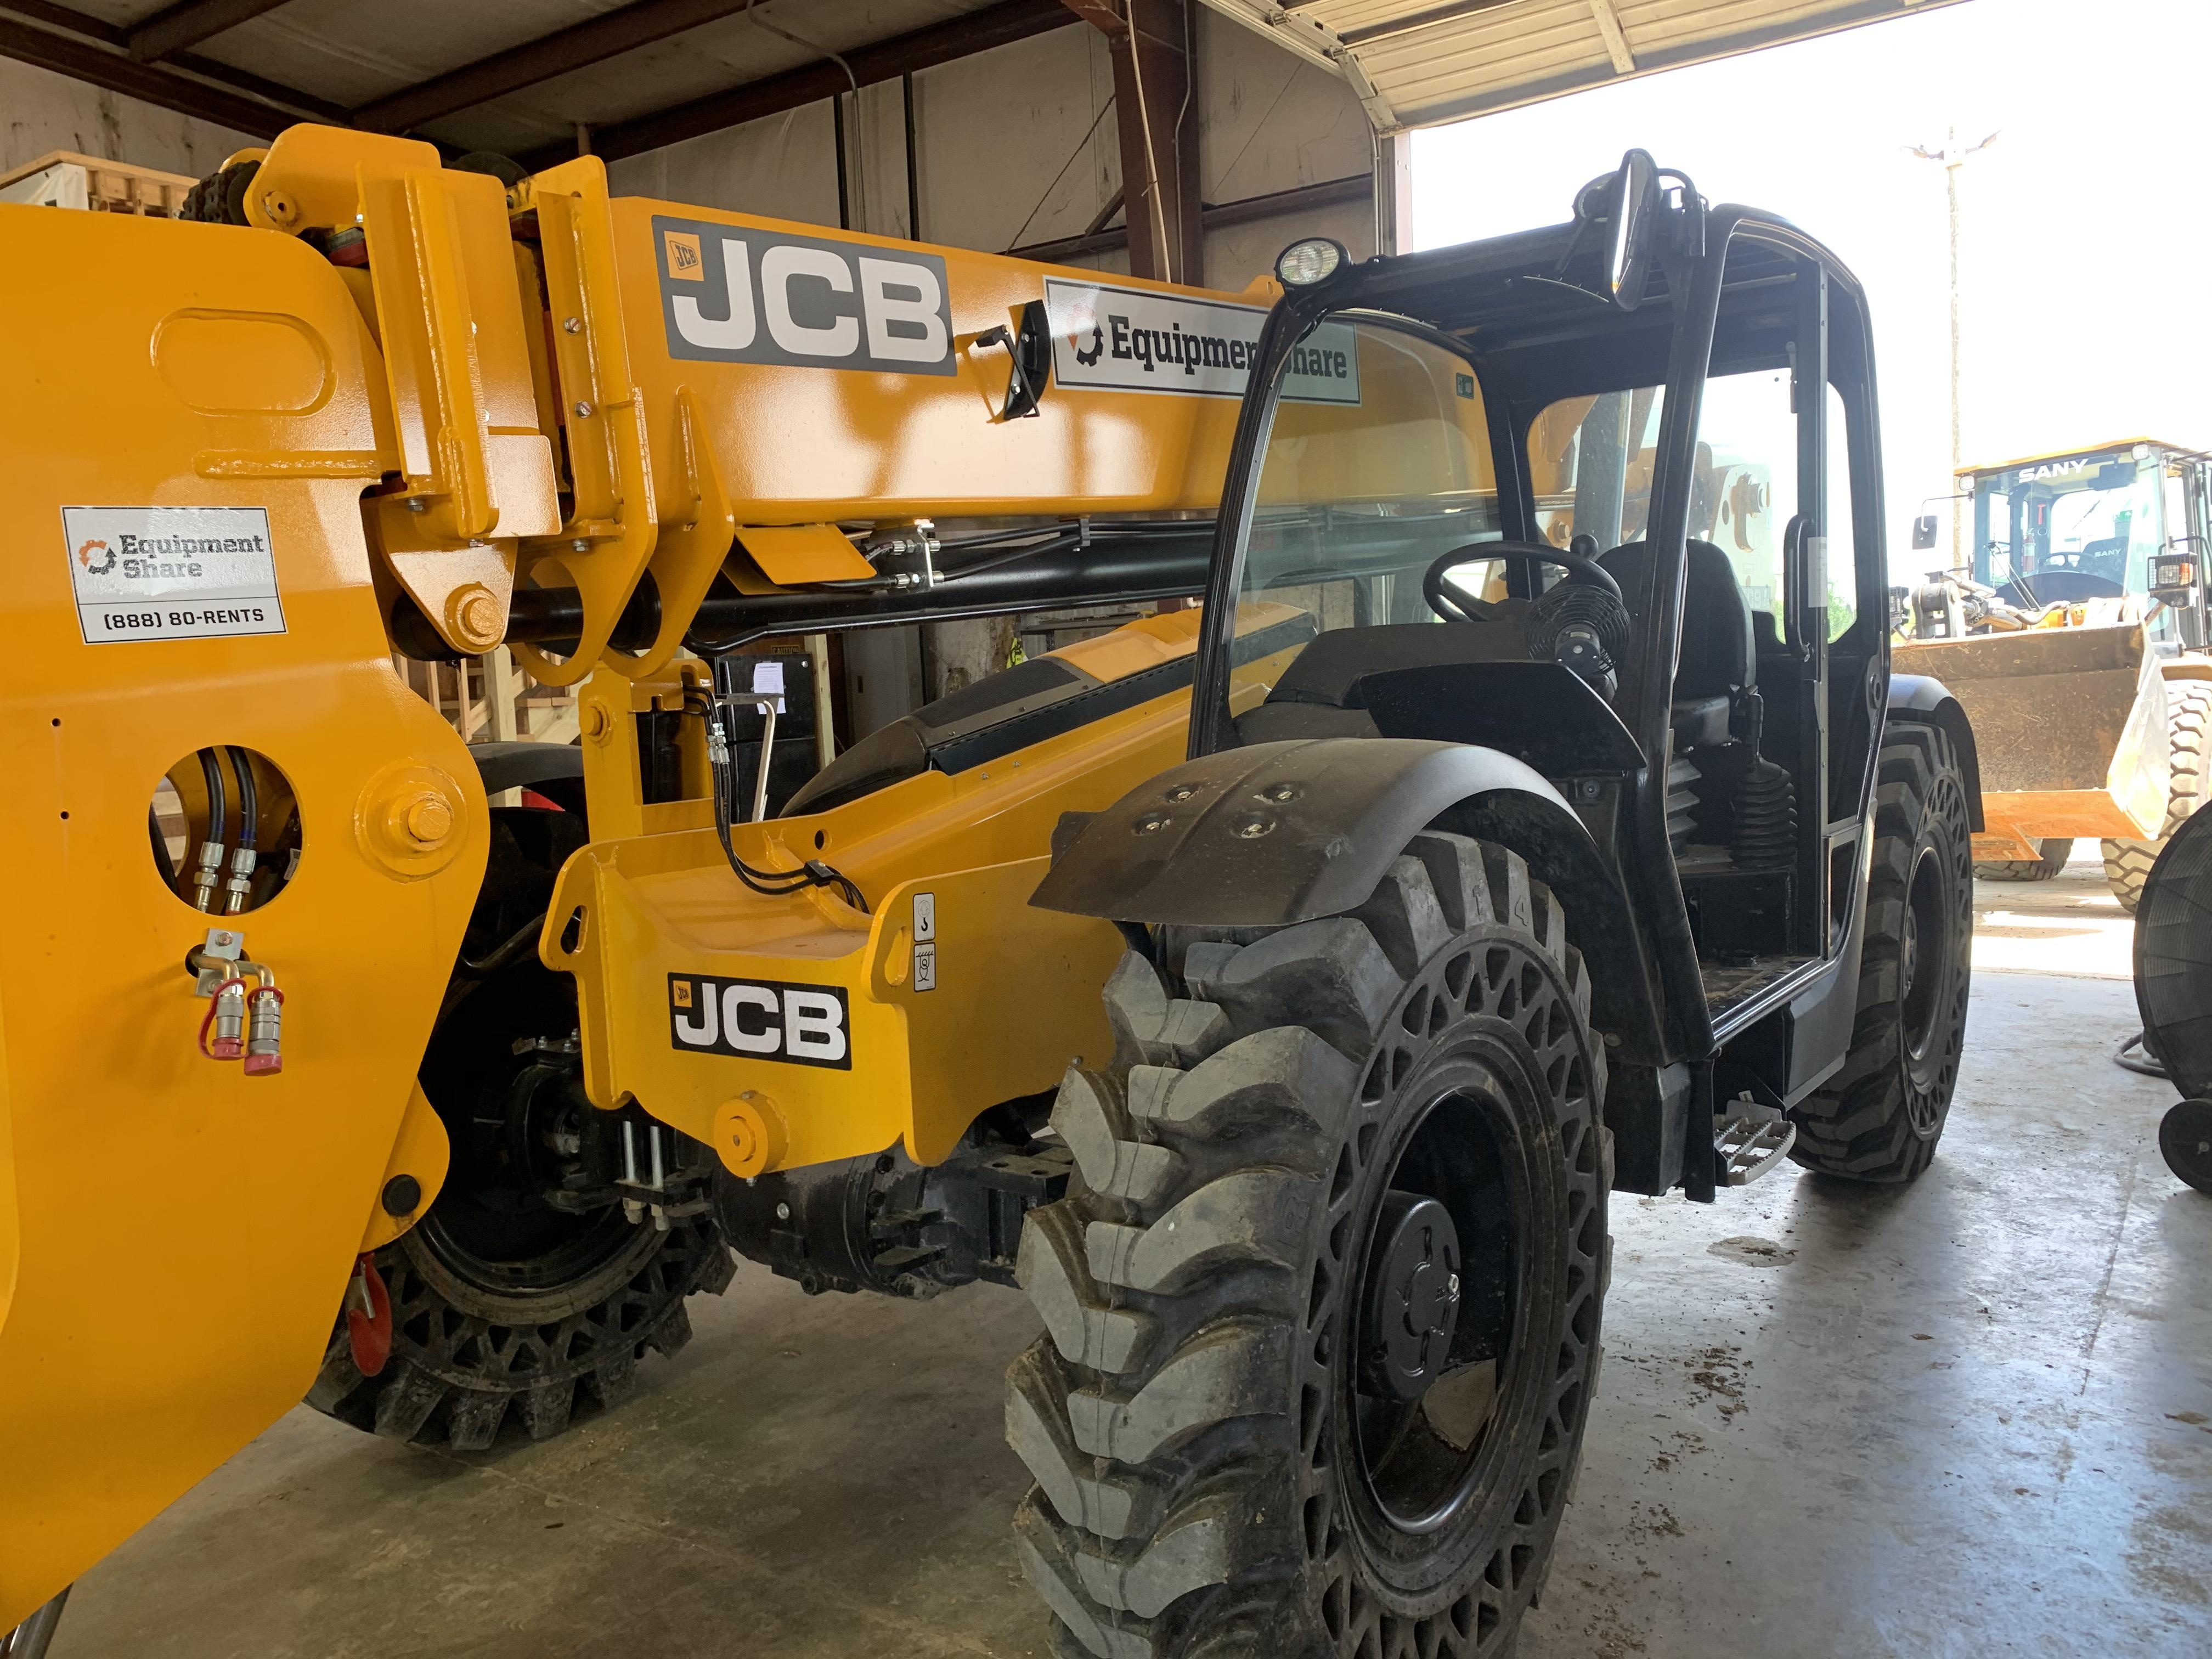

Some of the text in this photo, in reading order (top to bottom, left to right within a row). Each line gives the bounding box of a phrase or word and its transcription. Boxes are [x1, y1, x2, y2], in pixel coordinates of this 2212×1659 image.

[675, 245, 696, 267] JCB
[672, 238, 948, 363] JCB
[1108, 314, 1259, 375] Equipmen
[2018, 459, 2089, 483] SANY
[119, 534, 264, 558] Equipment
[2094, 549, 2121, 557] SANY
[123, 559, 203, 578] Share
[104, 608, 264, 630] (888) 80-RENTS
[678, 987, 689, 1000] JCB
[675, 983, 847, 1060] JCB
